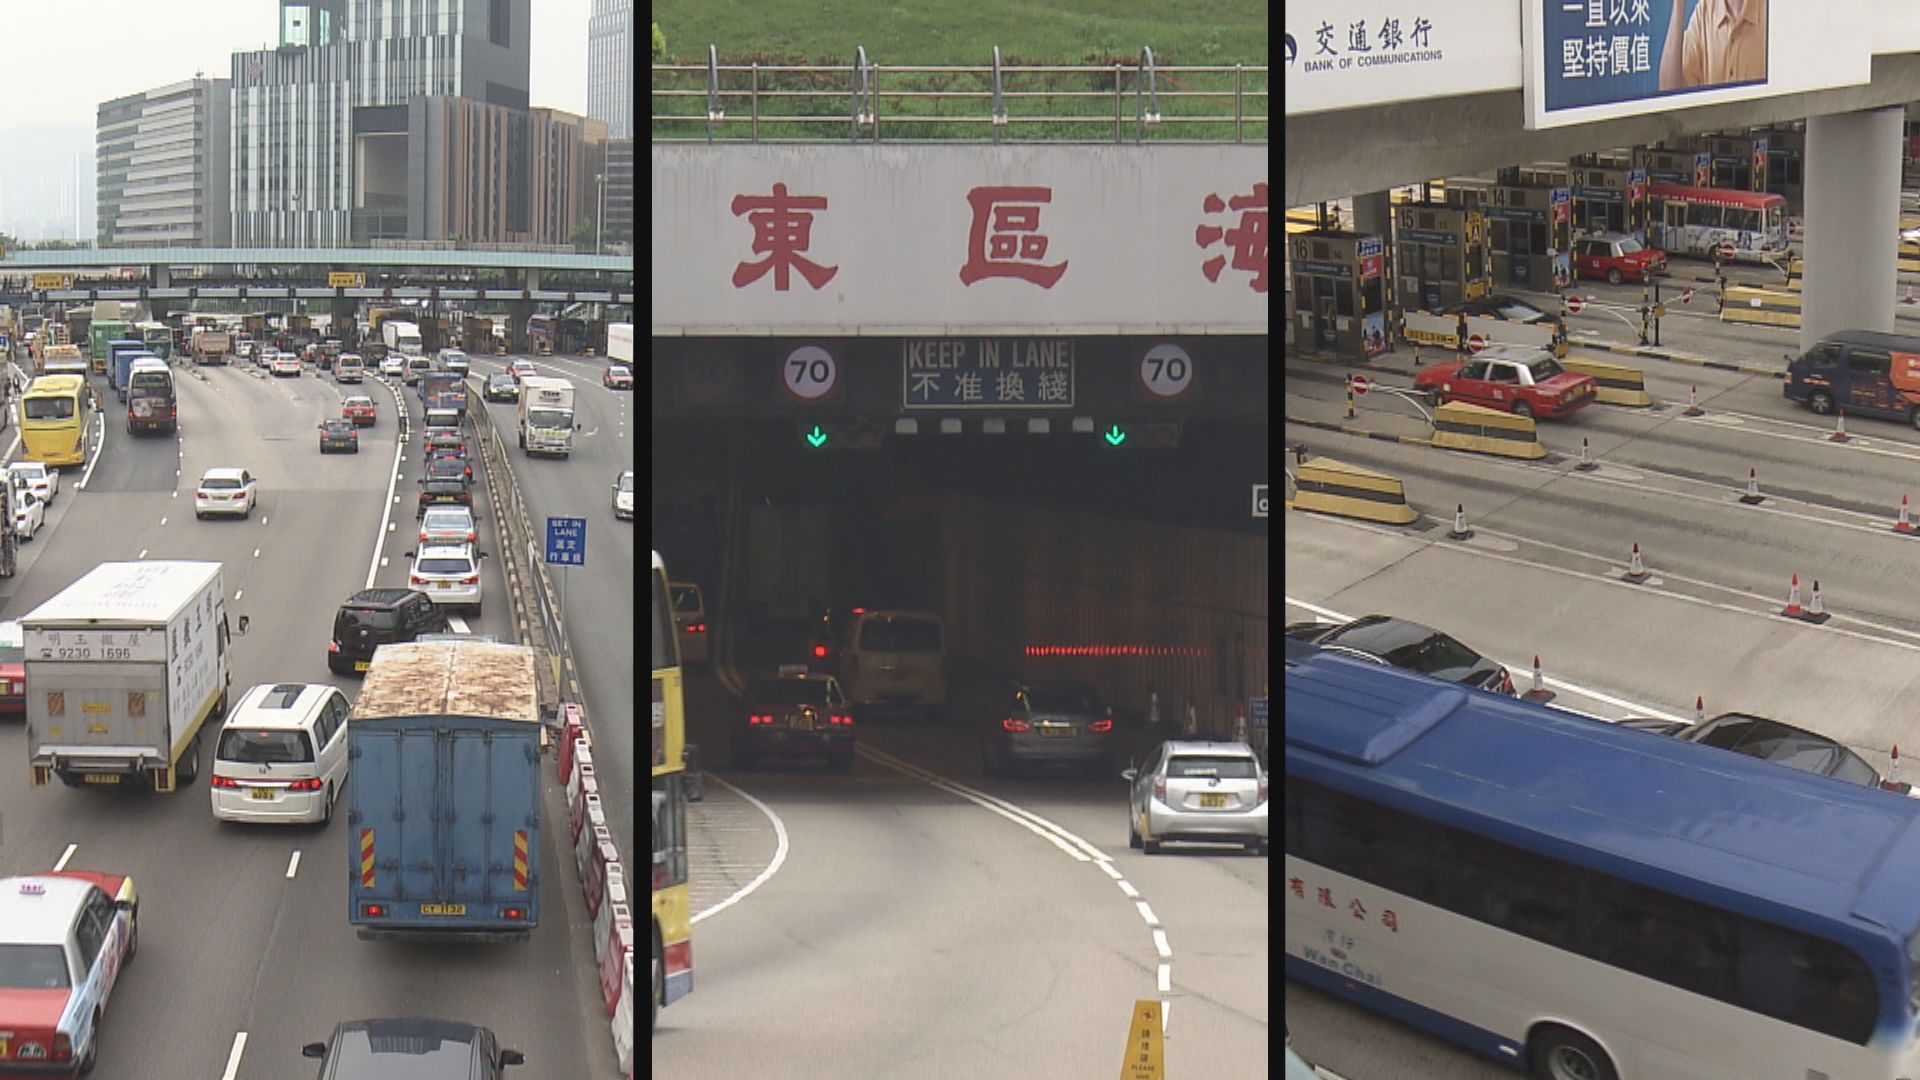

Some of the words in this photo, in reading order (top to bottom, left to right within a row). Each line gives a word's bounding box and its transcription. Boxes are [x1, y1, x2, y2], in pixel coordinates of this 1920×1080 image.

[1562, 0, 1650, 27] 一直以來
[1315, 16, 1432, 55] 交通銀行
[1304, 60, 1334, 73] BANK
[1339, 57, 1353, 69] OF
[1357, 50, 1443, 67] COMMUNICATIONS
[1562, 32, 1650, 78] 堅持價值
[1572, 169, 1584, 187] 13
[1493, 189, 1504, 206] 14
[1401, 208, 1414, 229] 15
[1294, 240, 1308, 260] 16
[909, 339, 966, 368] KEEP
[978, 339, 1000, 368] IN
[1012, 339, 1069, 368] LANE
[790, 360, 830, 383] 70
[1147, 358, 1187, 381] 70
[552, 520, 568, 528] GET
[572, 520, 582, 528] IN
[554, 528, 578, 537] LANE
[59, 647, 91, 659] 9230
[1304, 945, 1338, 969] Wan
[1343, 962, 1383, 987] Chai
